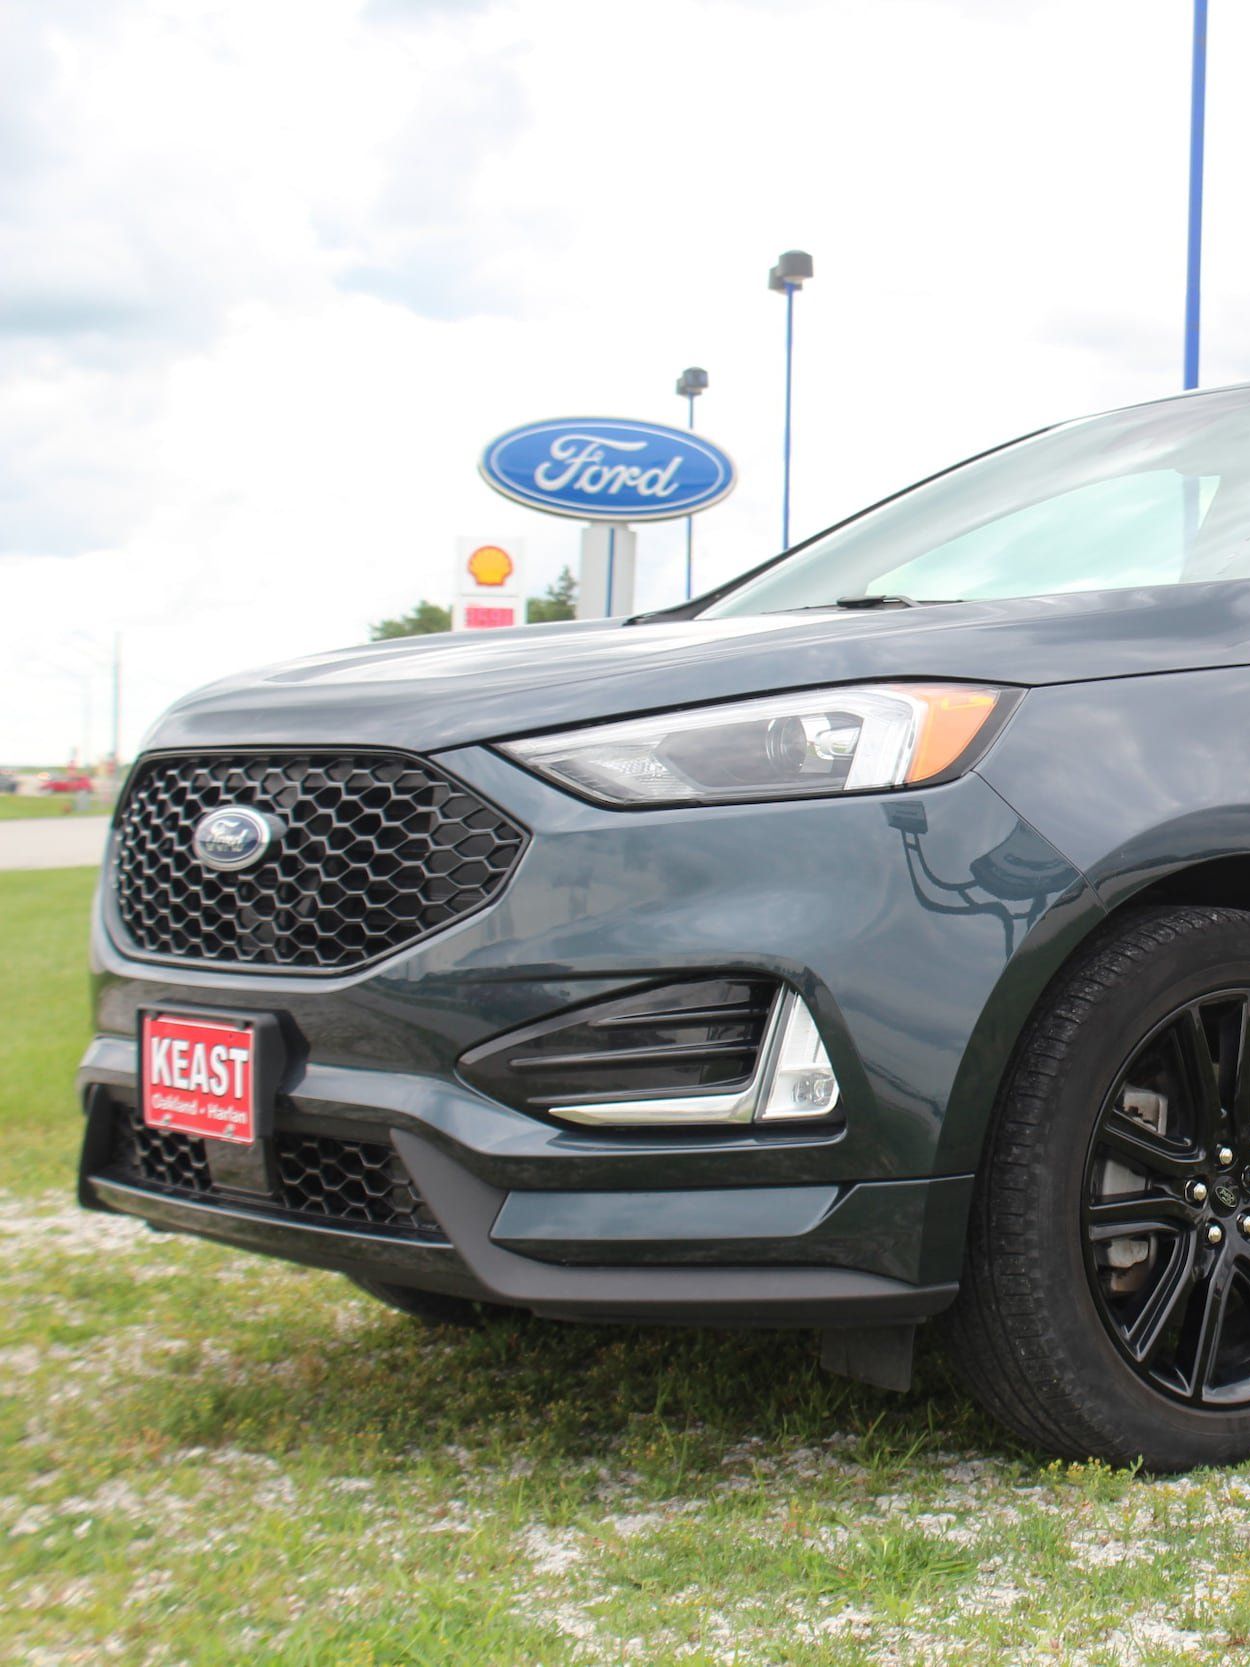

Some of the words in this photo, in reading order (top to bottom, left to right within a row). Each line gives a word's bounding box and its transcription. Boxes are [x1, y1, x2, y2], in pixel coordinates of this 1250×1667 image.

[534, 434, 683, 497] Ford
[206, 820, 249, 852] Ford
[151, 1036, 249, 1100] KEAST
